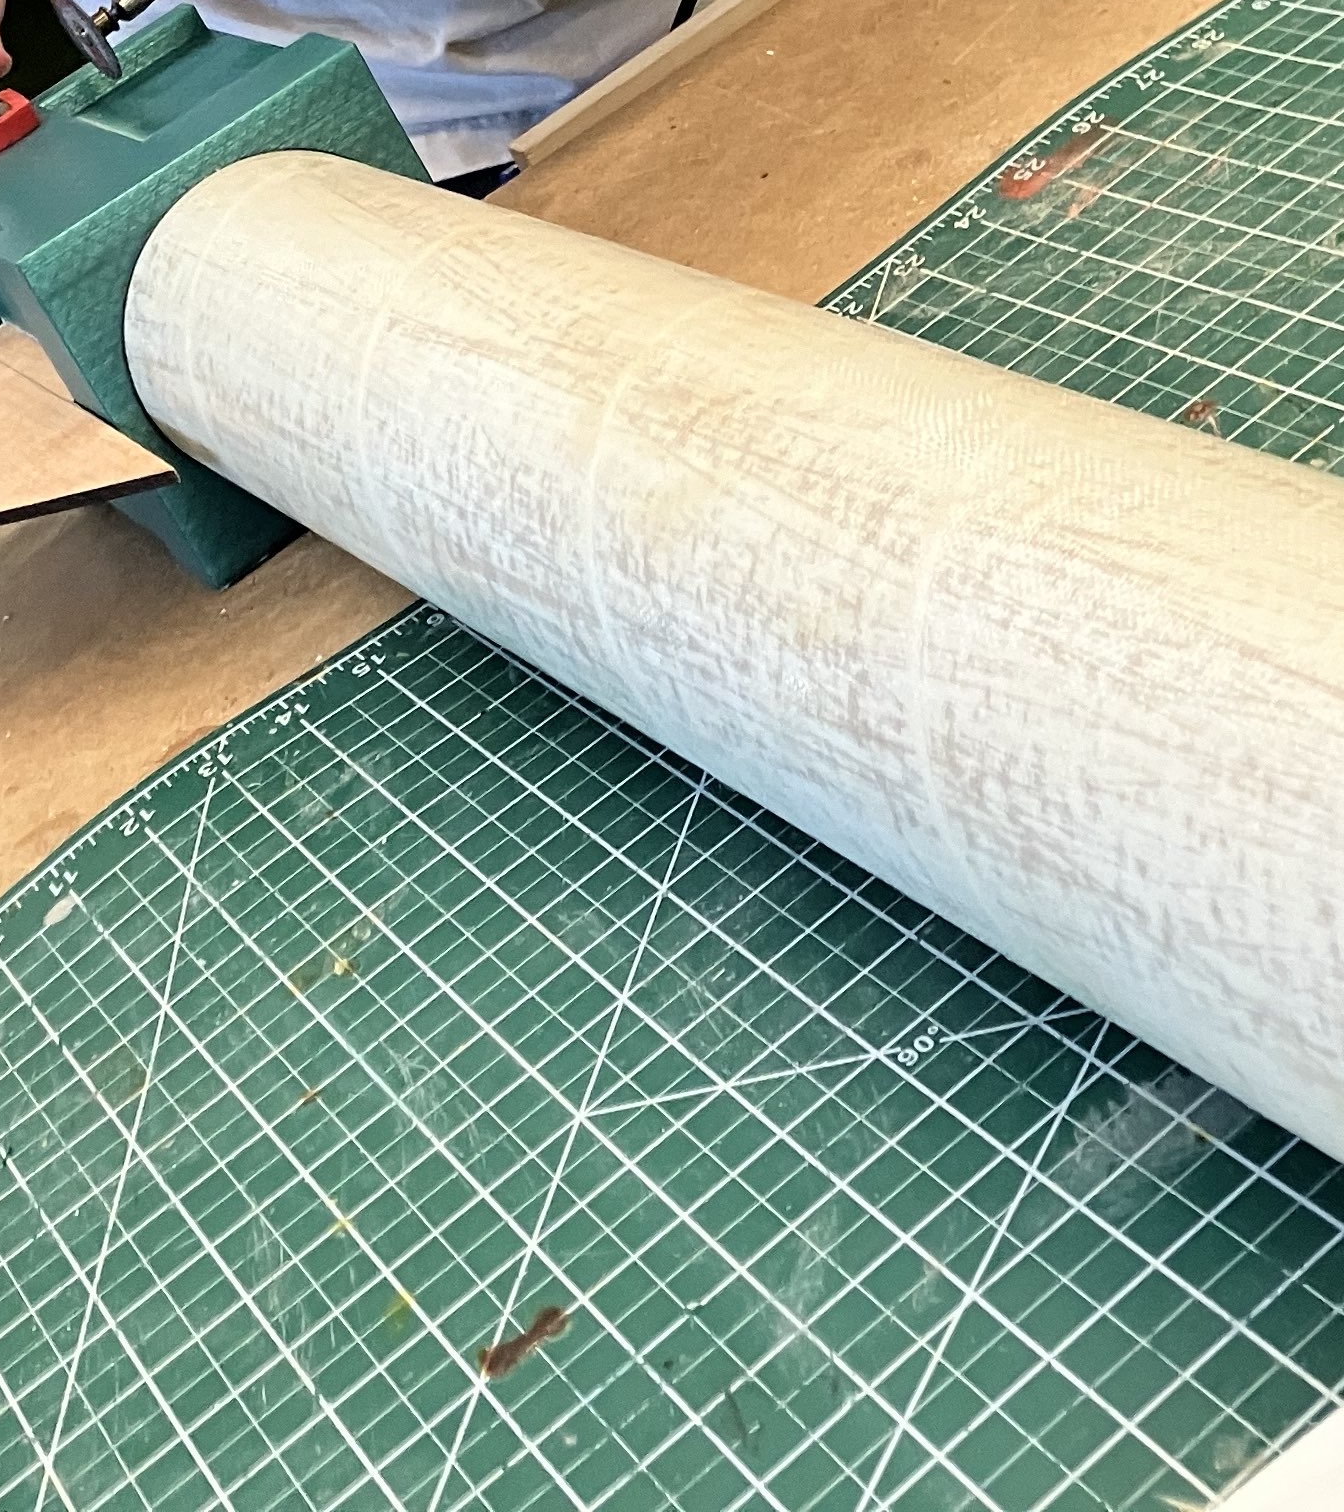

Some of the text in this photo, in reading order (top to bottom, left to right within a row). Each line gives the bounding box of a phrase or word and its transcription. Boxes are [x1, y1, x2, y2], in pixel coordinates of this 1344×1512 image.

[1191, 29, 1224, 49] 28
[1136, 68, 1165, 91] 27
[1071, 110, 1105, 134] 26
[1013, 157, 1046, 181] 25
[953, 205, 986, 229] 24
[893, 254, 925, 277] 23
[351, 653, 386, 678] 15
[274, 703, 310, 726] 14
[197, 752, 234, 778] 13
[119, 809, 156, 836] 12
[48, 870, 78, 896] 11
[897, 1025, 939, 1066] 90°
